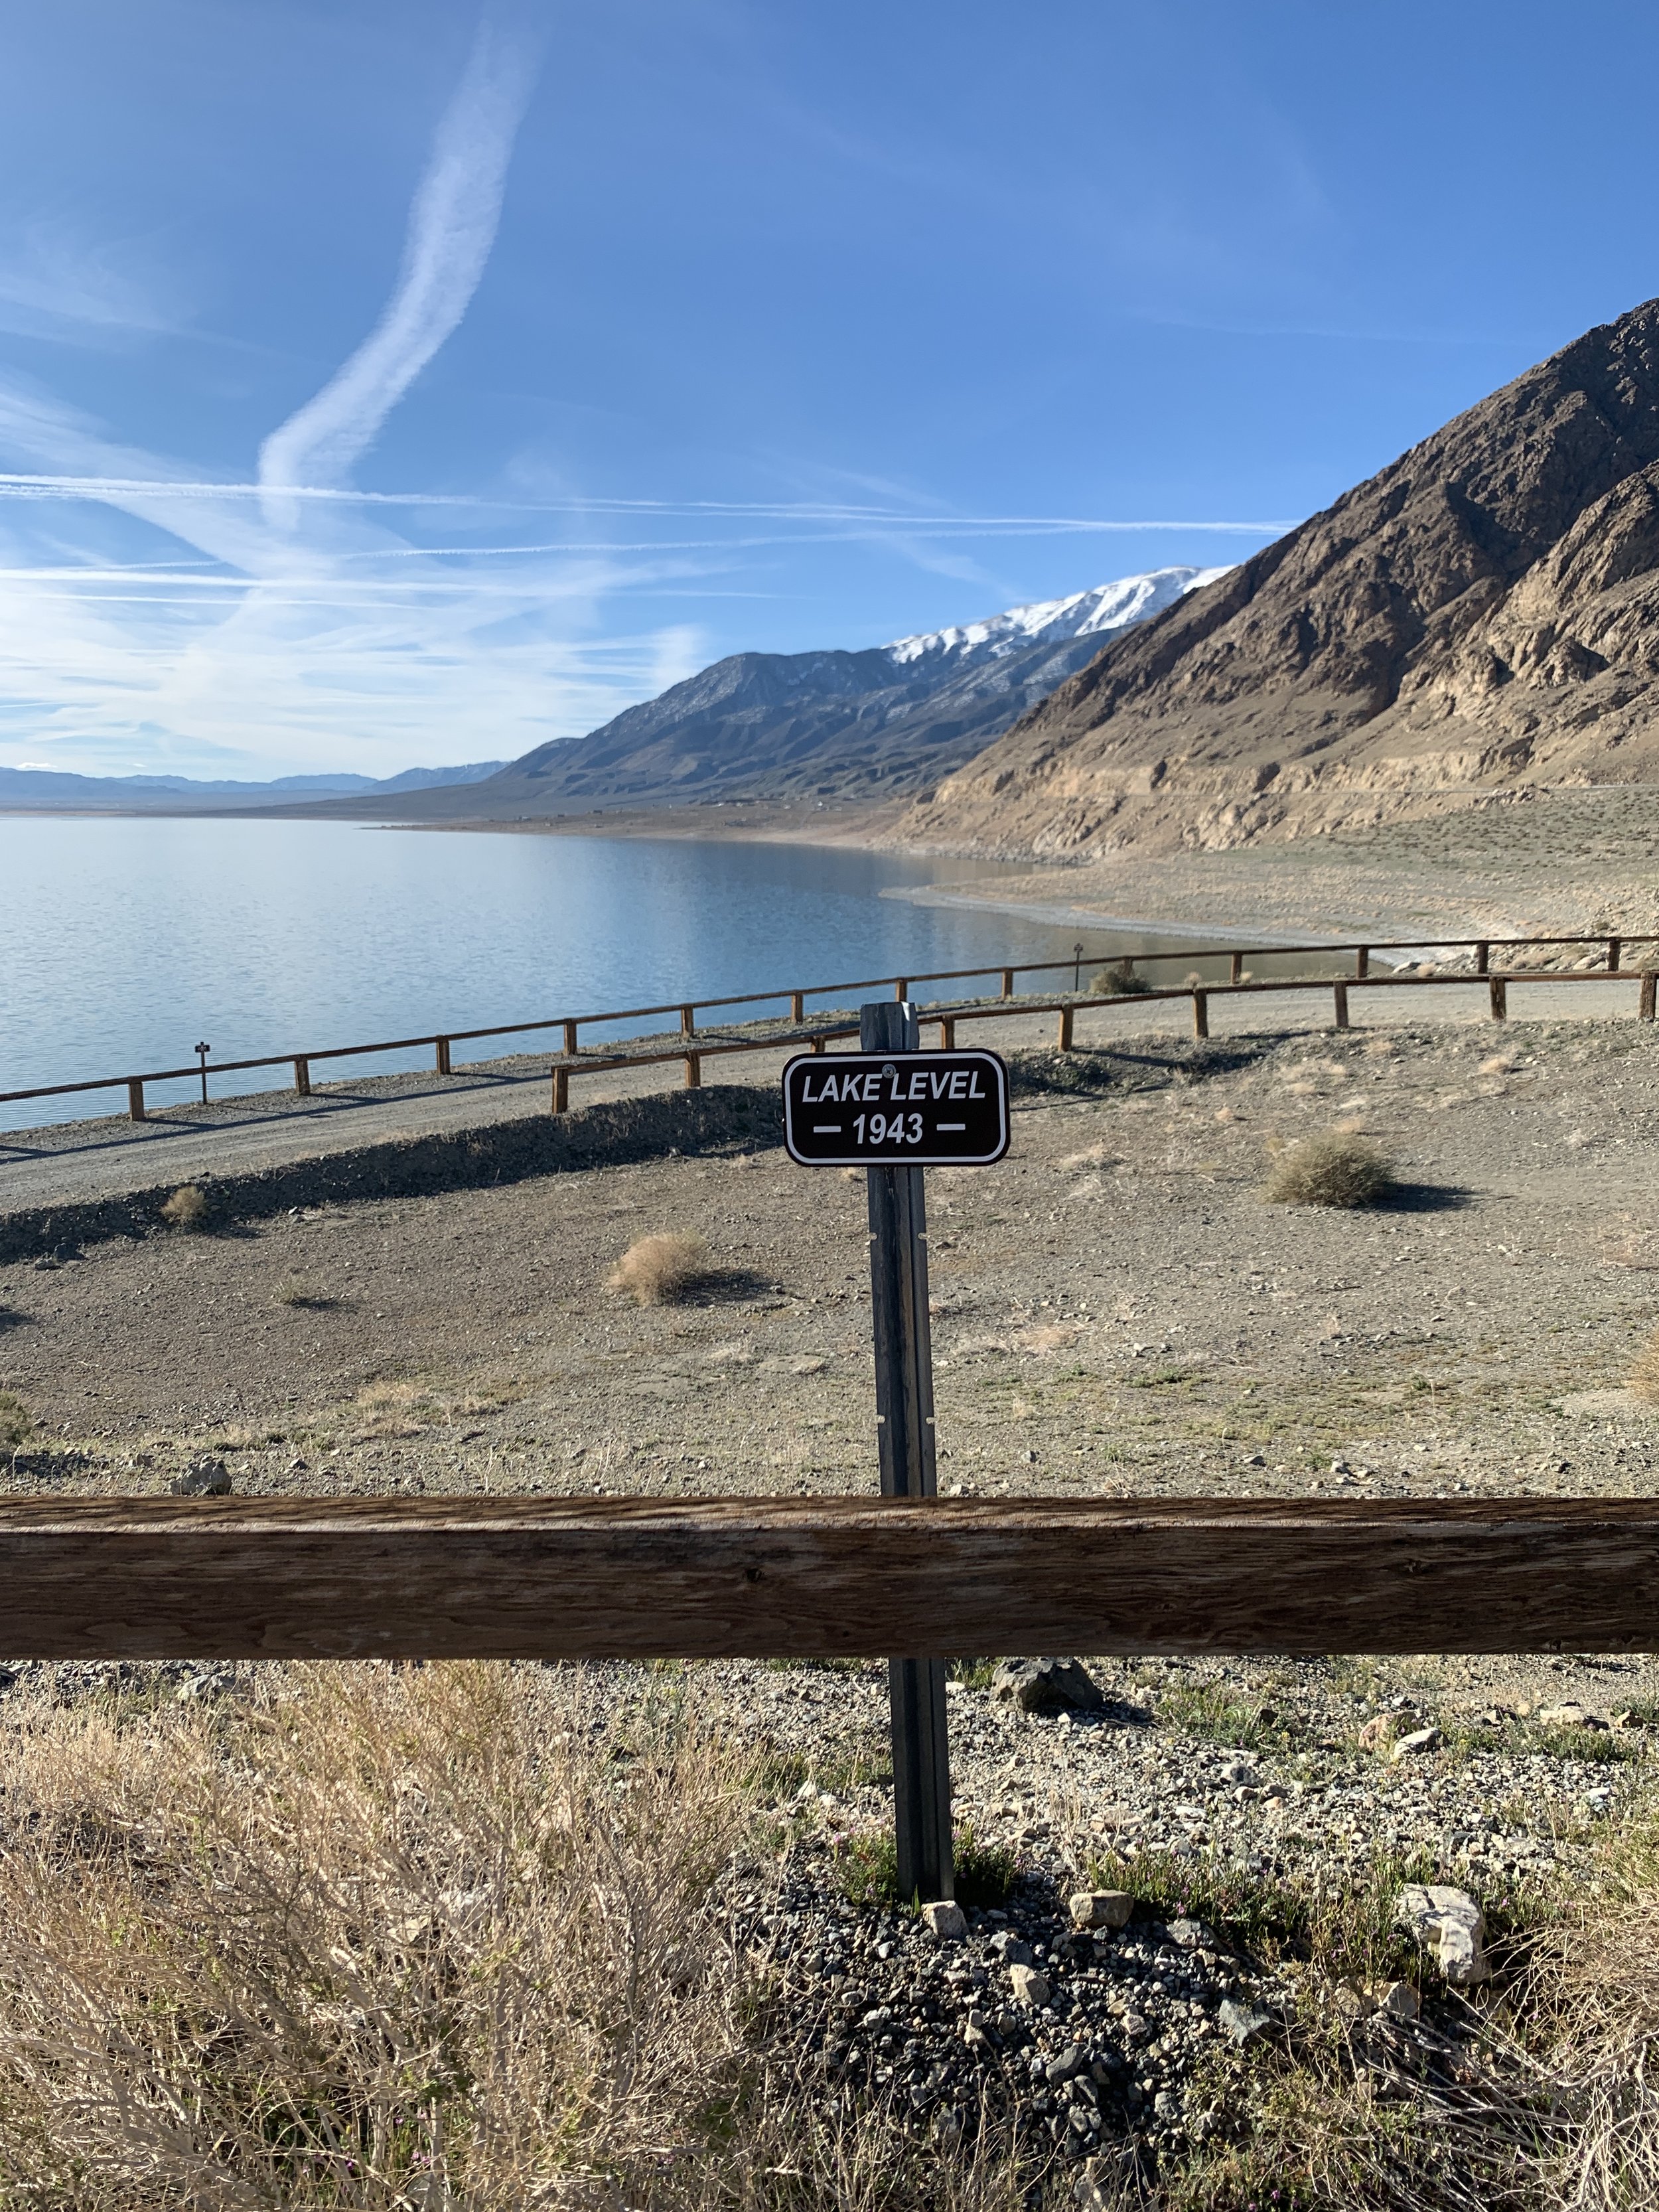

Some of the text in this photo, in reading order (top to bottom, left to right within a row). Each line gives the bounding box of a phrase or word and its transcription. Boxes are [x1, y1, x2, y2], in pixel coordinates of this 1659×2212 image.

[802, 1070, 985, 1102] LAKE LEVEL
[853, 1113, 923, 1144] 1943
